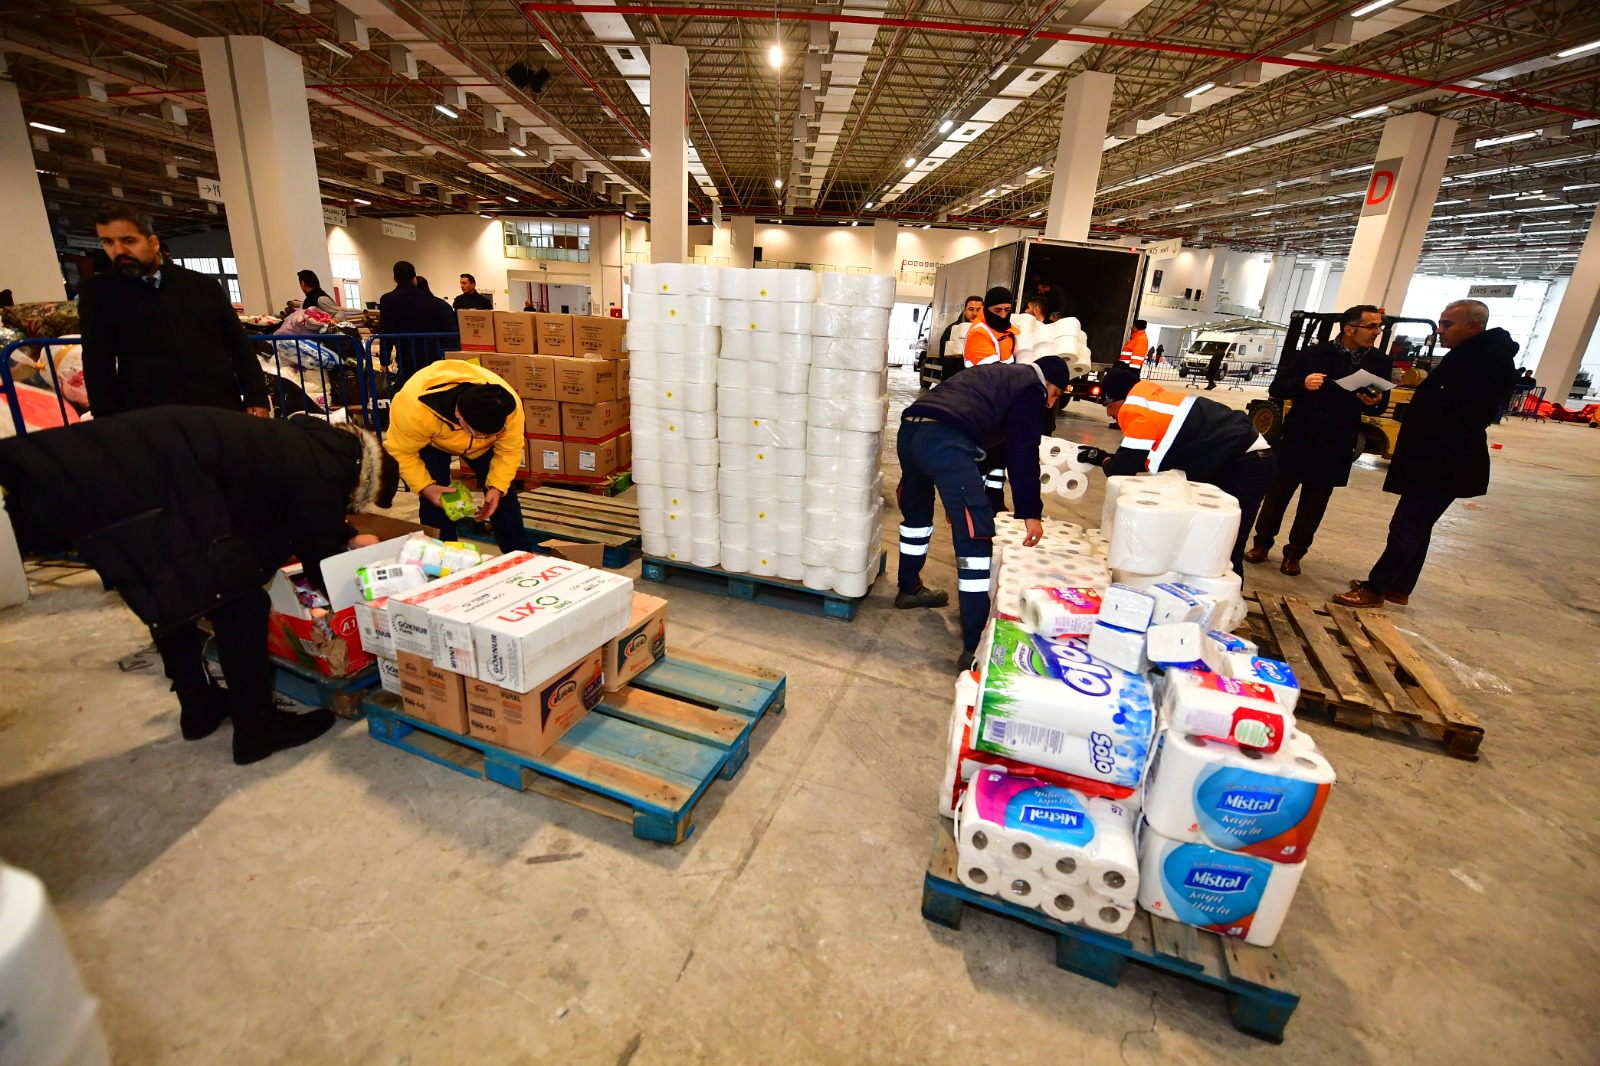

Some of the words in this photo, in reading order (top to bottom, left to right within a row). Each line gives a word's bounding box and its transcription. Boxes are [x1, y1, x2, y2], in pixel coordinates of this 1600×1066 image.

[1366, 170, 1394, 205] D
[1224, 794, 1275, 811] Mistral
[1030, 808, 1078, 826] Mistral
[1192, 871, 1242, 888] Mistral
